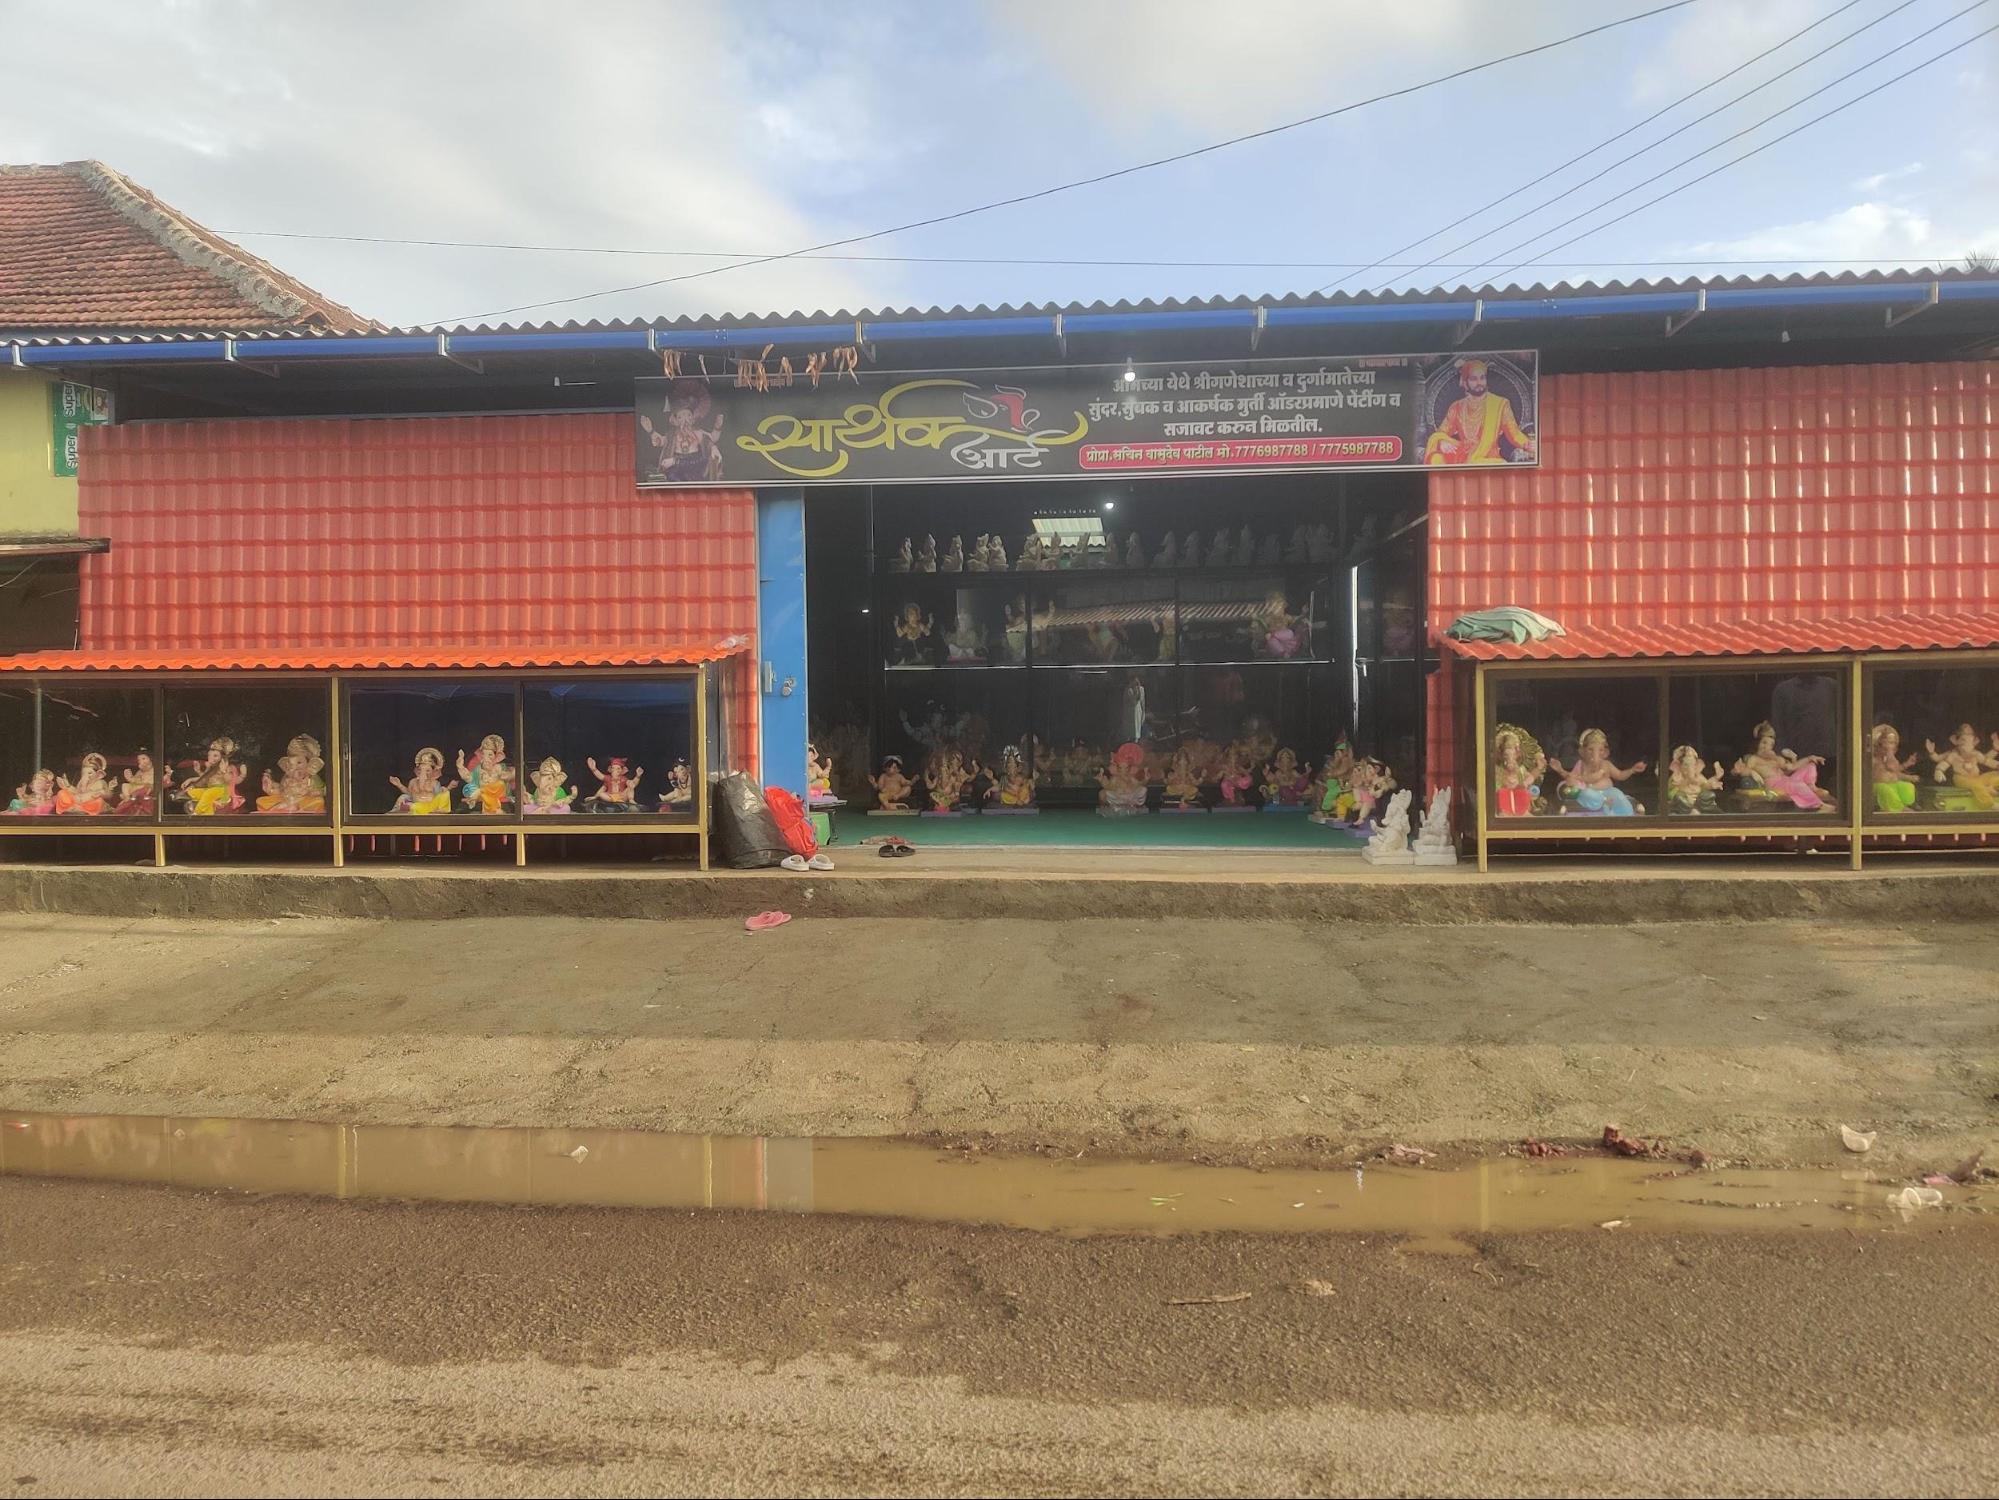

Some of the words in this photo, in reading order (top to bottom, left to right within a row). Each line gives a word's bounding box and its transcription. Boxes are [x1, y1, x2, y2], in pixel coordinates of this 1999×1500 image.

[1166, 372, 1190, 391] येथे
[1193, 370, 1279, 391] श्रीगणेशाच्या
[1283, 373, 1294, 387] व
[1297, 367, 1376, 392] दुर्गामातेच्या
[1162, 400, 1174, 414] व
[1177, 394, 1234, 414] आकर्षक
[1237, 391, 1265, 417] मुर्ती
[1389, 393, 1402, 407] व
[736, 379, 1088, 477] सार्थक
[1163, 422, 1215, 436] सजावट
[1217, 420, 1257, 436] करुन
[1260, 414, 1323, 434] मिळतील.
[67, 435, 77, 469] Super
[951, 429, 1070, 469] आर्ट
[1146, 445, 1180, 465] वासुदेव
[1183, 444, 1214, 460] पाटील
[1319, 441, 1394, 456] 7775987788
